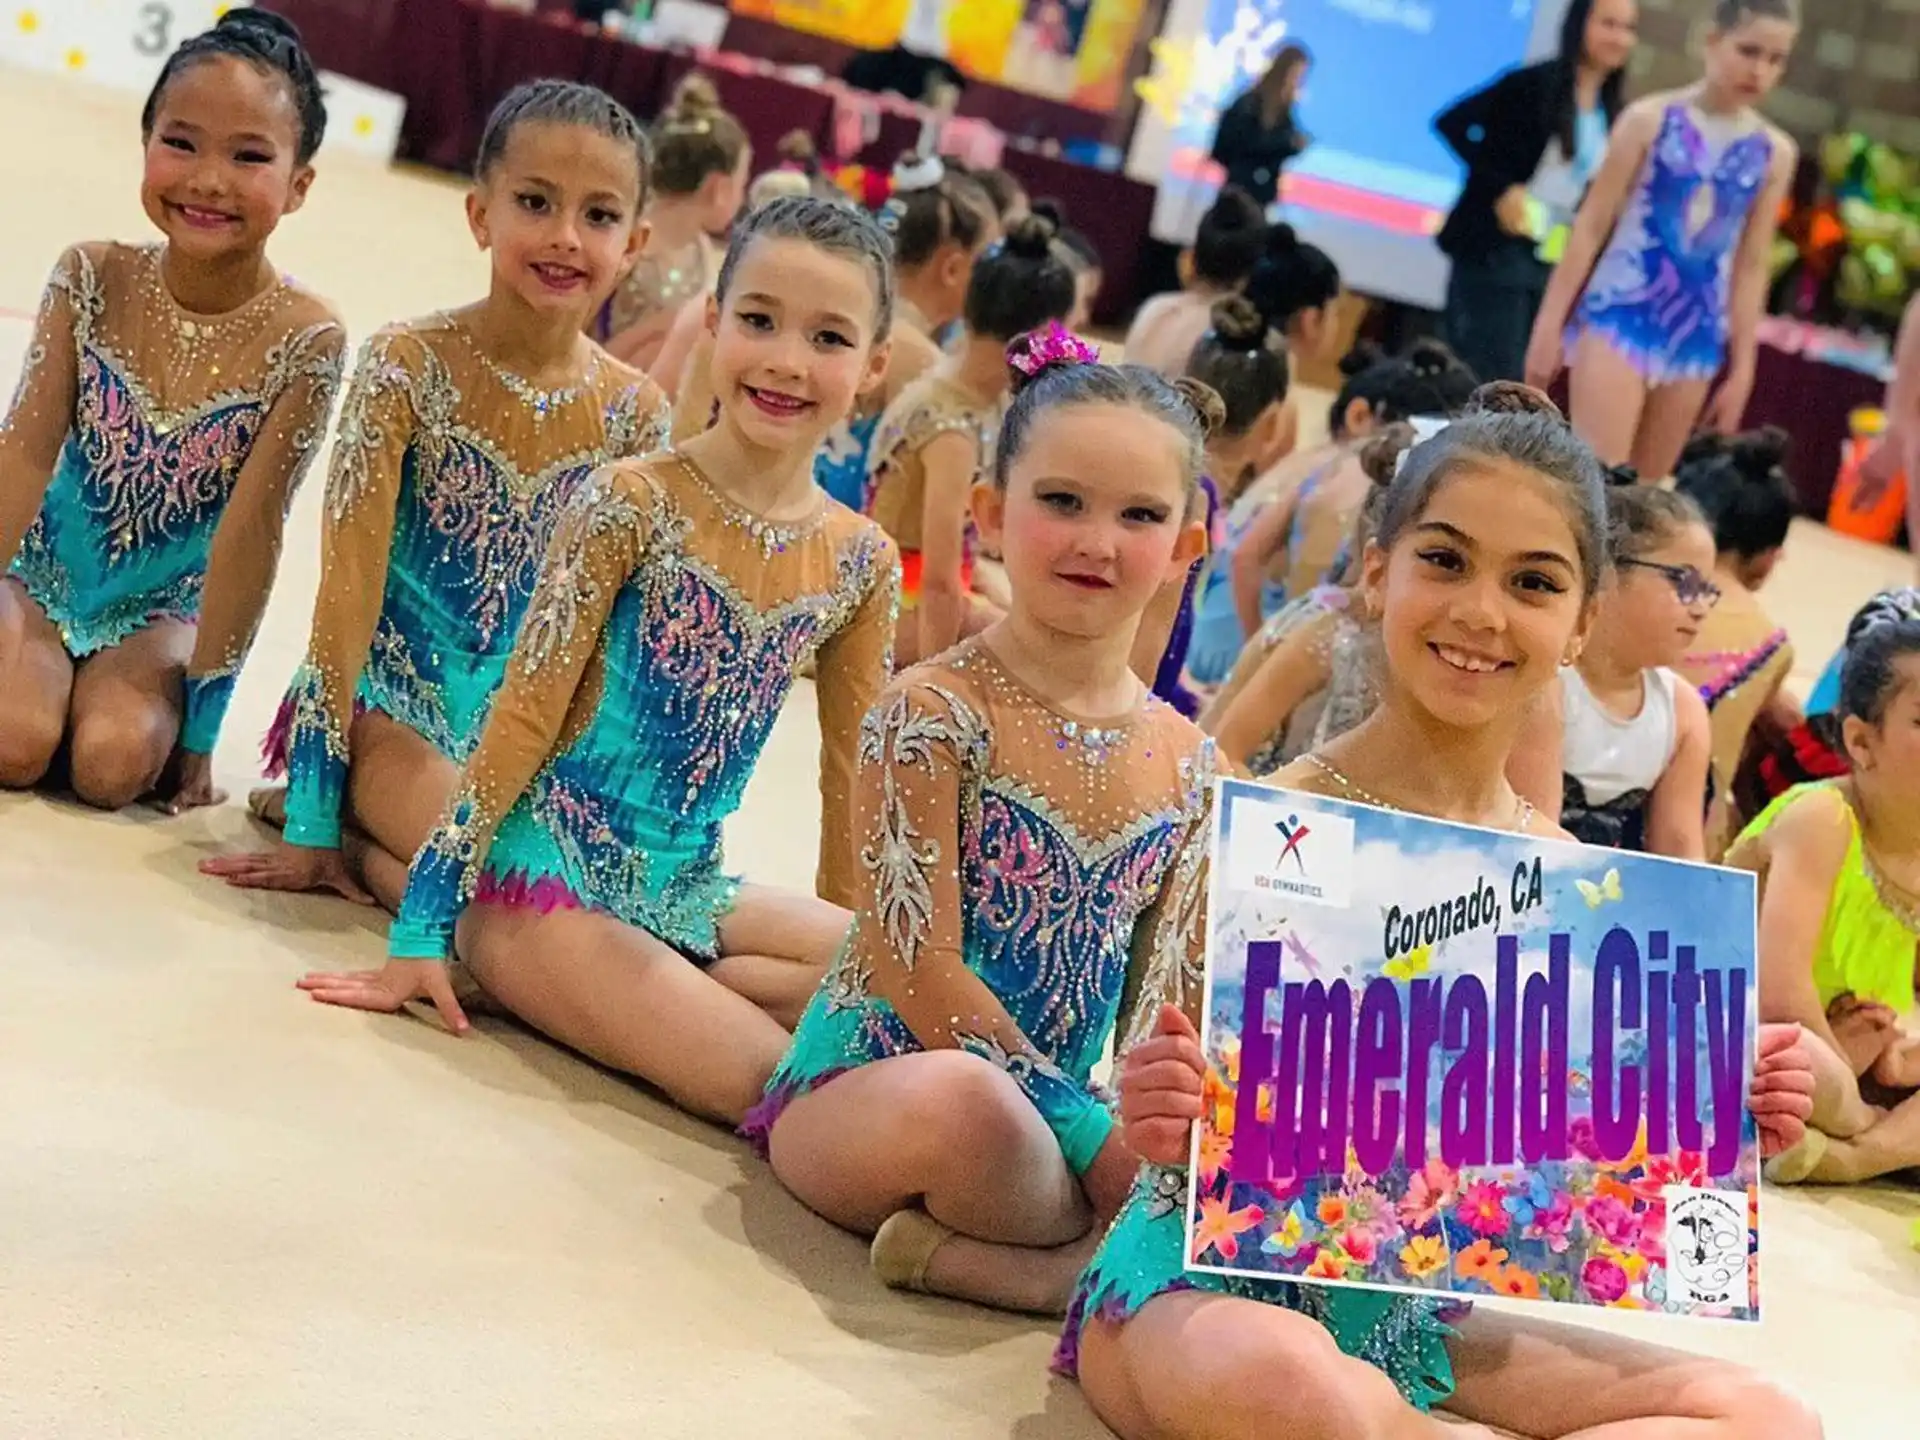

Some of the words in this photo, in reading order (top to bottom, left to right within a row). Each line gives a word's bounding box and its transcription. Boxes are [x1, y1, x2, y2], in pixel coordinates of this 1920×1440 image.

[132, 1, 174, 57] 3
[1384, 875, 1502, 960] Coronado,
[1511, 856, 1542, 914] CA
[1229, 932, 1571, 1182] Emerald
[1592, 927, 1746, 1178] City
